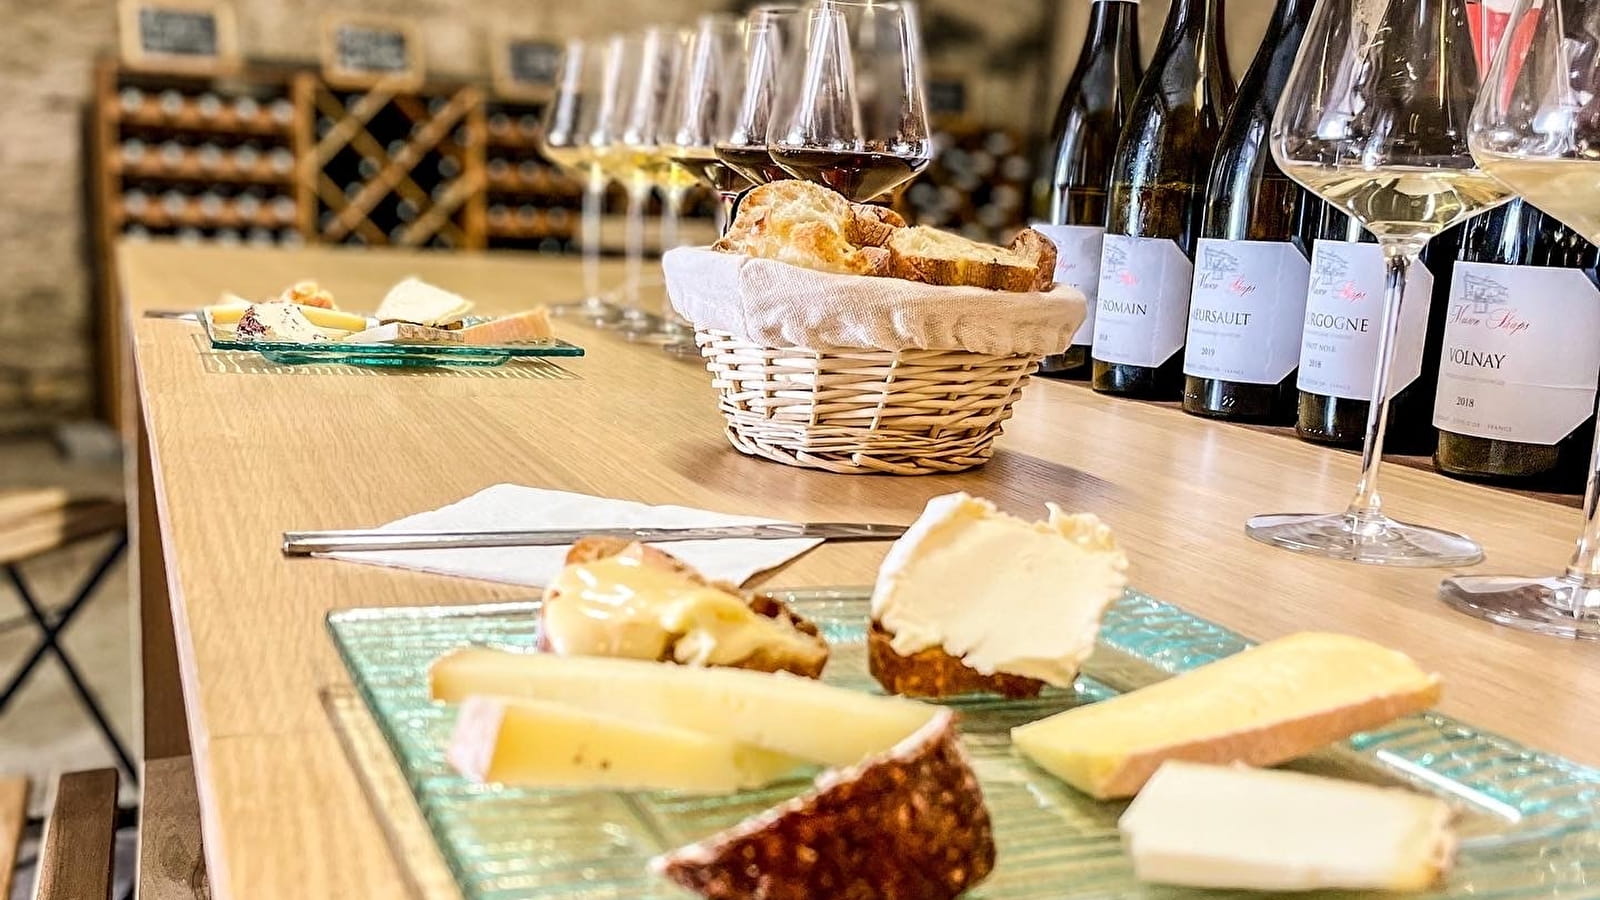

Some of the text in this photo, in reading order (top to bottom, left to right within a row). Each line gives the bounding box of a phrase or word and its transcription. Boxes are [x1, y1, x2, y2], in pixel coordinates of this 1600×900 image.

[1102, 299, 1147, 316] ROMAIN
[1193, 308, 1252, 326] EURSAULT
[1306, 312, 1369, 333] RGOGNE
[1201, 347, 1216, 357] 2019
[1449, 347, 1506, 369] VOLNAY
[1455, 396, 1475, 408] 2018
